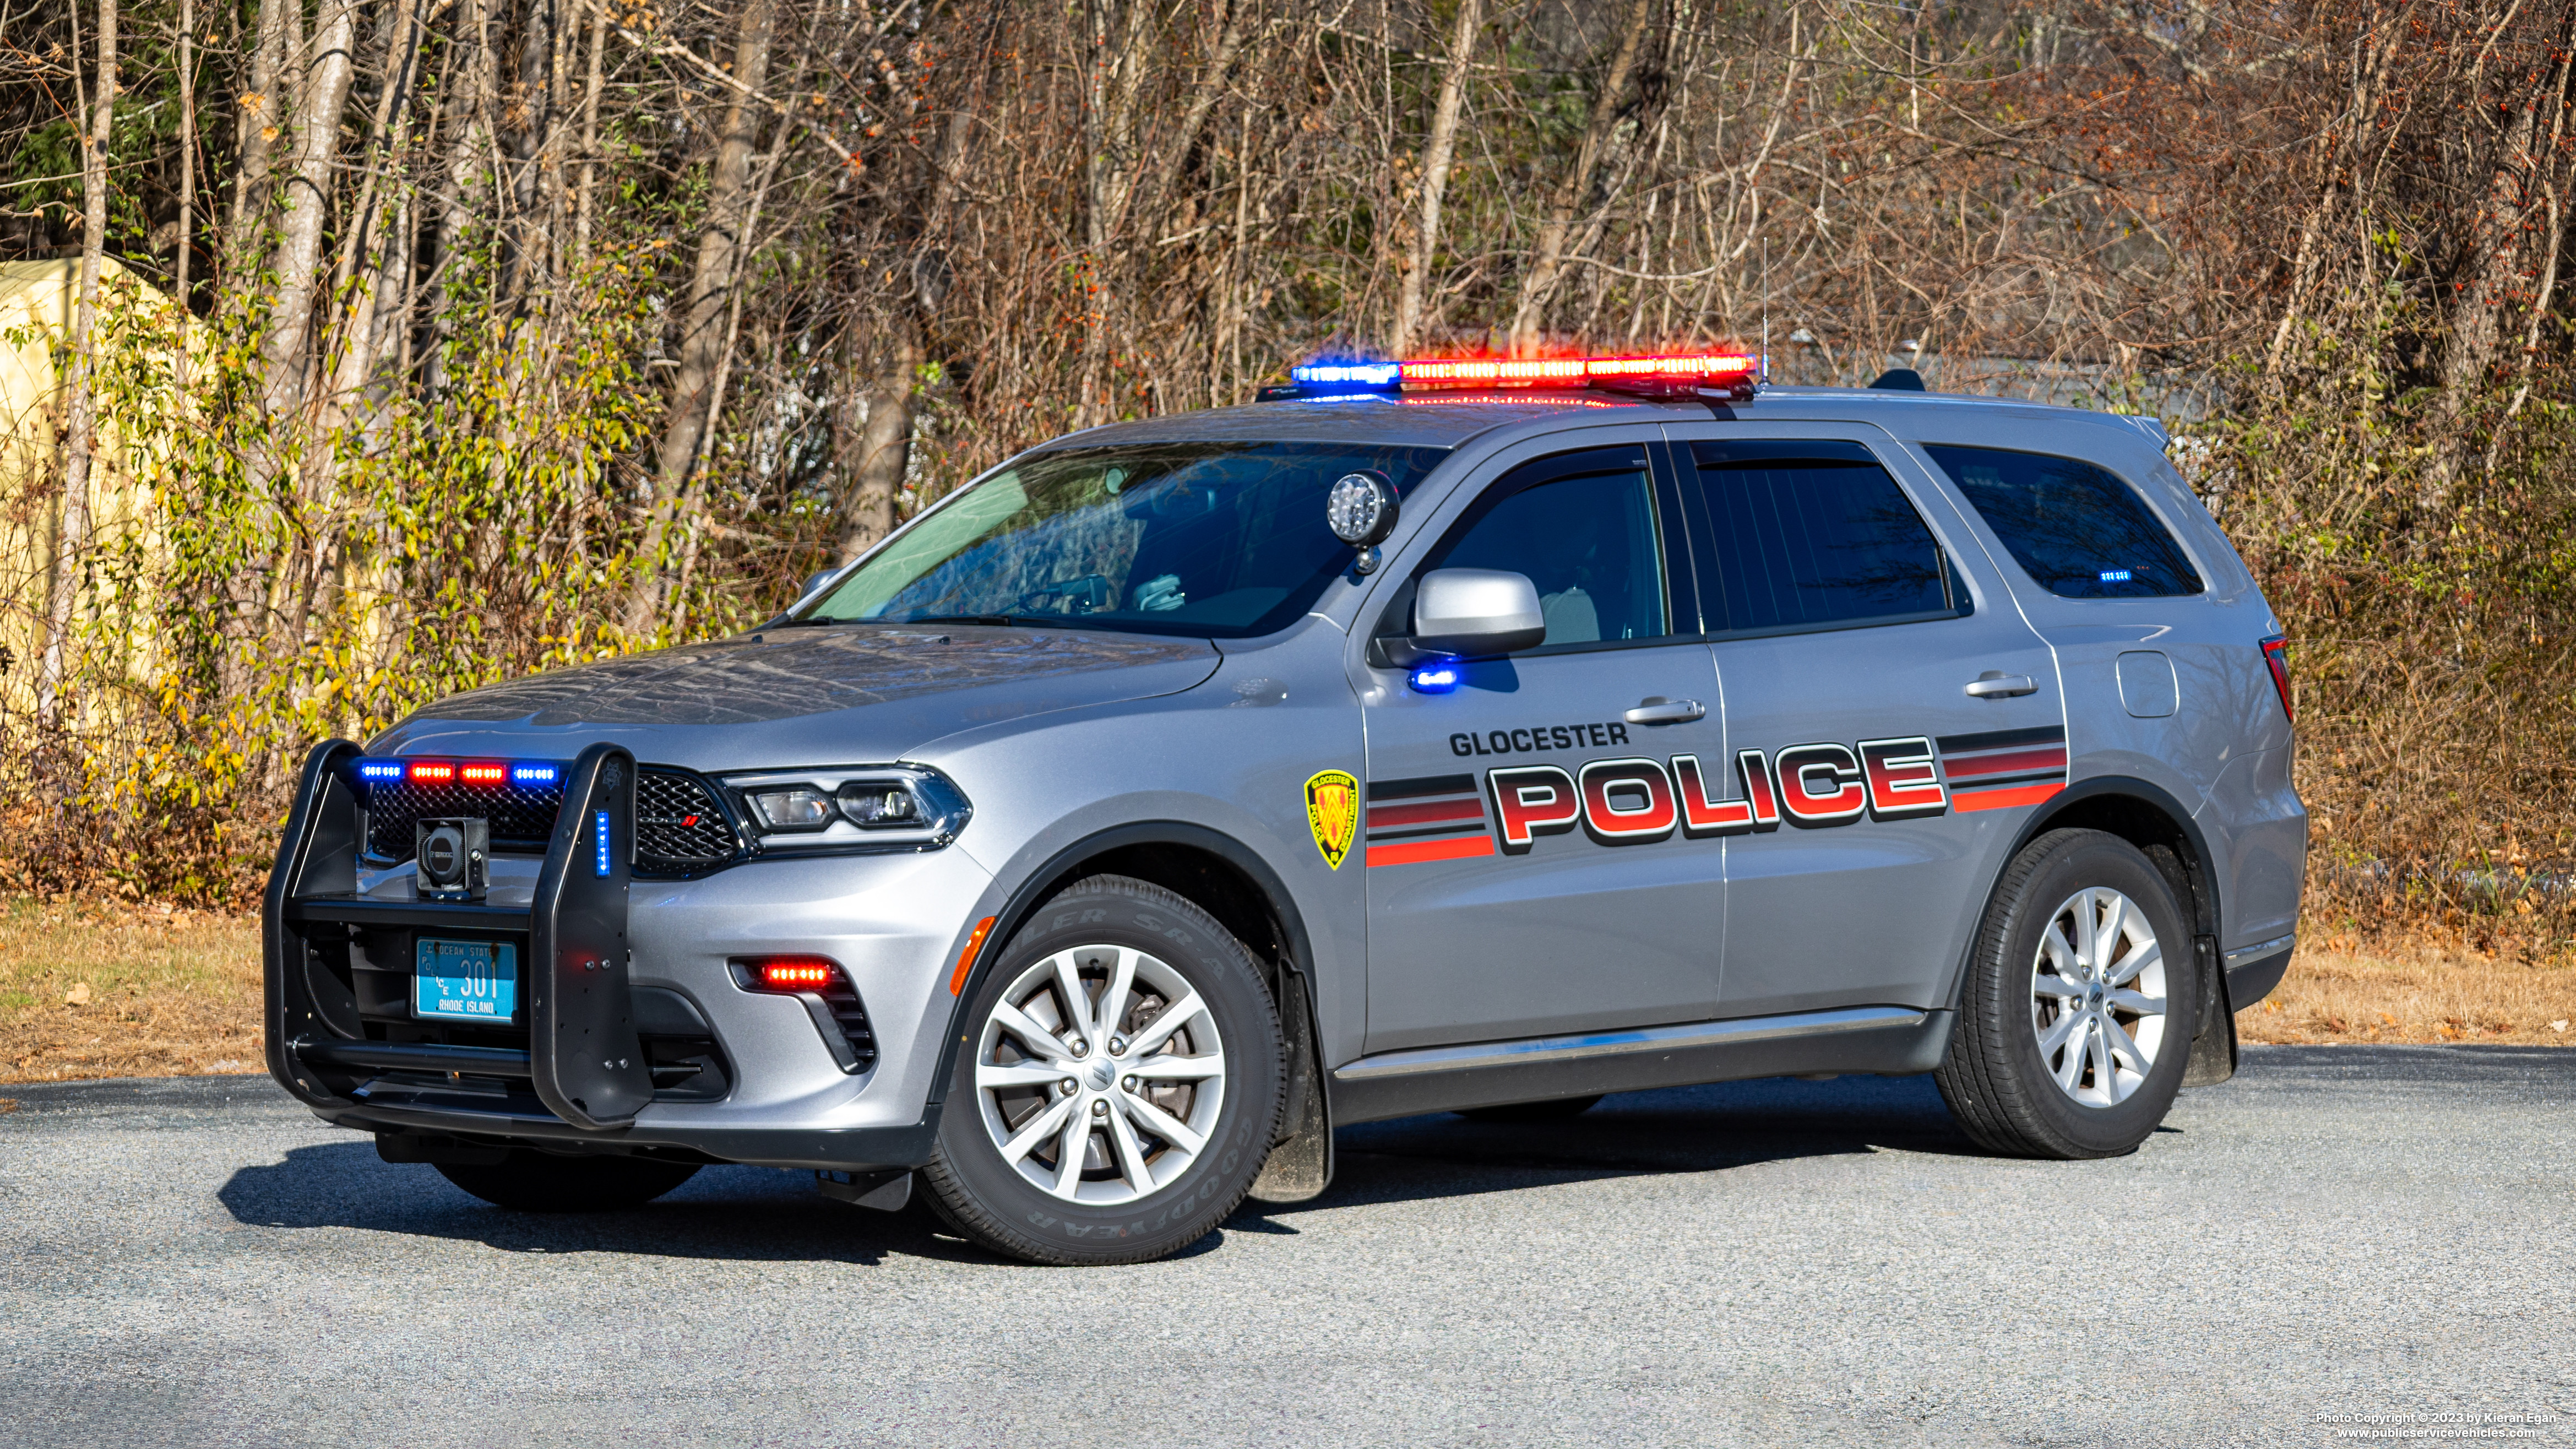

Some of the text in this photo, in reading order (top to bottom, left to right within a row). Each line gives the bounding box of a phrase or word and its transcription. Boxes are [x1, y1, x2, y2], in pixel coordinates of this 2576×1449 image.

[1449, 722, 1629, 757] GLOCESTER
[1311, 775, 1351, 789] GLOCESTER
[1484, 734, 1947, 856] POLICE
[1310, 804, 1325, 844] POLICE
[1339, 789, 1355, 852] DEPARTMENT
[439, 945, 464, 956] OCEAN
[460, 959, 497, 998] 301
[439, 999, 493, 1014] RHODE ISLAND
[1026, 1117, 1254, 1240] GOODYEAR
